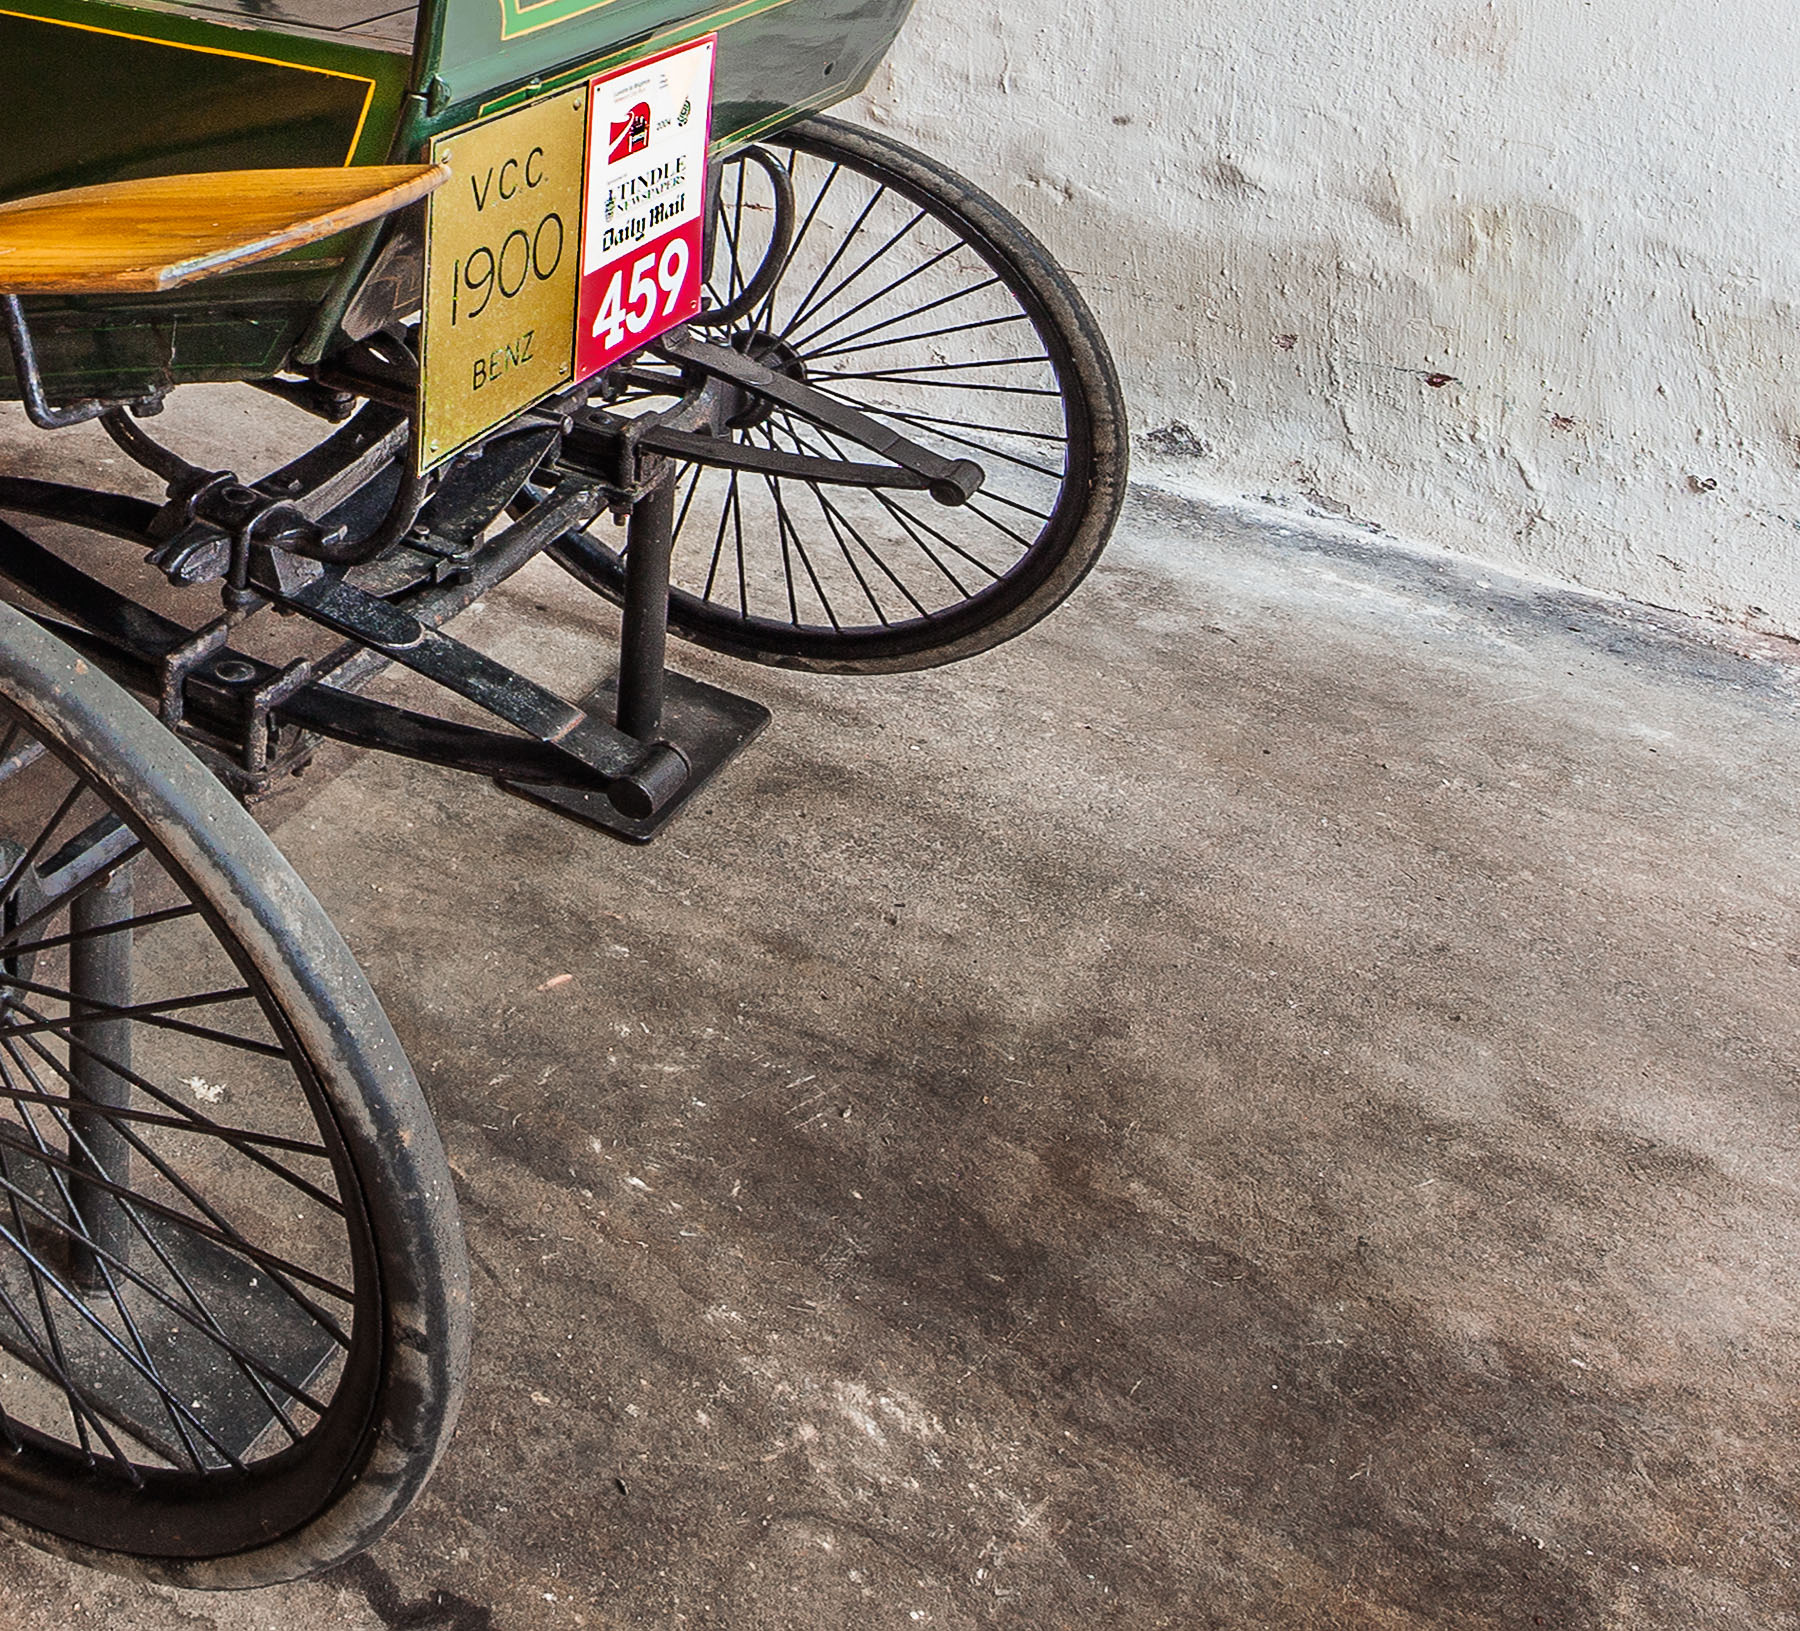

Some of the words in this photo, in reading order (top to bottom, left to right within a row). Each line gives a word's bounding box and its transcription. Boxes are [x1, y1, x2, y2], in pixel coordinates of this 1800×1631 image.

[616, 154, 687, 200] TINDLE
[616, 175, 687, 212] NEWSPAPERS
[602, 217, 646, 252] Daily
[649, 192, 685, 228] Mail
[451, 212, 564, 326] 1900
[591, 237, 689, 350] 459
[473, 329, 535, 391] BENZ
